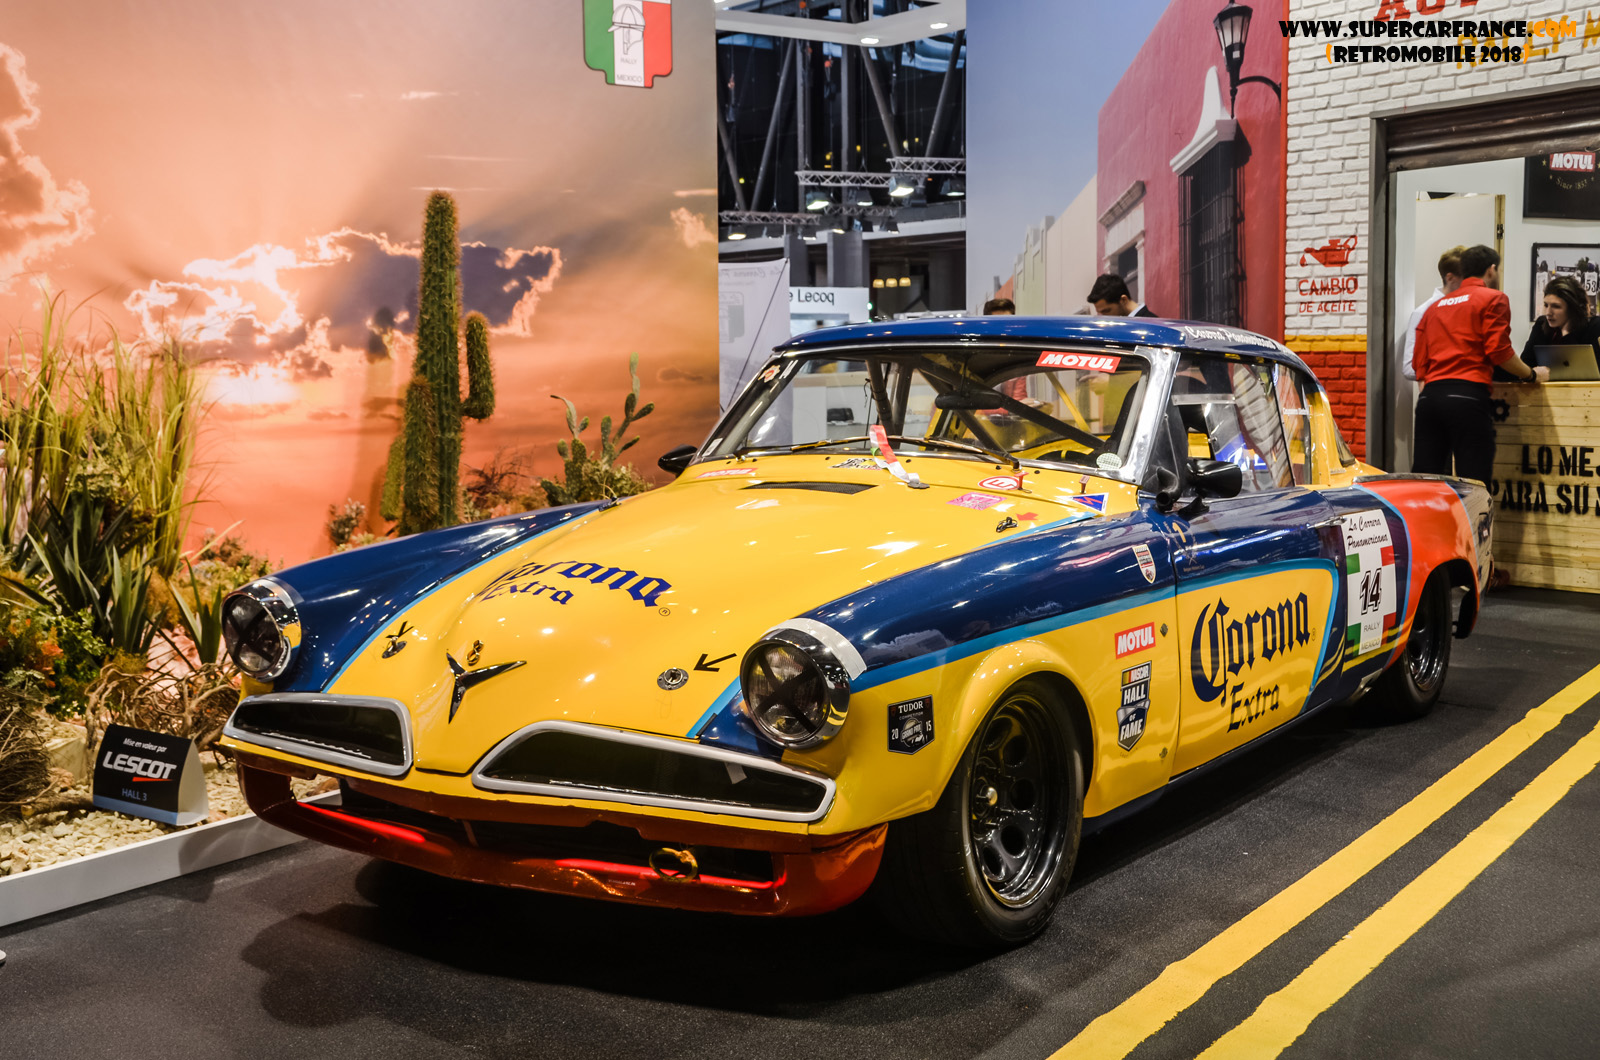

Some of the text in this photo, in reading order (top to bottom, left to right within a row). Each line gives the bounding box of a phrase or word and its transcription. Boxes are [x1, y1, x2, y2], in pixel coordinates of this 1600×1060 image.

[620, 56, 637, 65] RALLY
[616, 73, 643, 83] MEXICO
[1551, 153, 1594, 170] MOTUL
[1298, 276, 1359, 296] CAMBIO
[798, 289, 835, 305] Lecoq
[1437, 294, 1470, 308] MOTUL
[1299, 299, 1356, 313] DE ACEITE
[1041, 353, 1114, 370] MOTUL
[1521, 444, 1600, 480] LO ME
[1556, 484, 1589, 515] SU
[1348, 516, 1382, 532] La Carrera
[1347, 533, 1388, 550] Panamericana
[1360, 567, 1382, 615] 14
[1363, 621, 1381, 633] RALLY
[1117, 626, 1155, 655] MOTUL
[1360, 637, 1381, 651] MEXICO
[1190, 591, 1311, 708] Corona
[1123, 683, 1146, 705] HALL
[898, 700, 924, 714] TUDOR
[1226, 681, 1280, 734] Extra
[1129, 713, 1137, 722] OF
[891, 728, 899, 740] 20
[925, 720, 932, 732] 15
[1120, 718, 1143, 741] FAME
[123, 737, 135, 746] Mise
[142, 742, 158, 751] valeur
[102, 751, 178, 779] LESCOT
[122, 788, 148, 801] HALL 3
